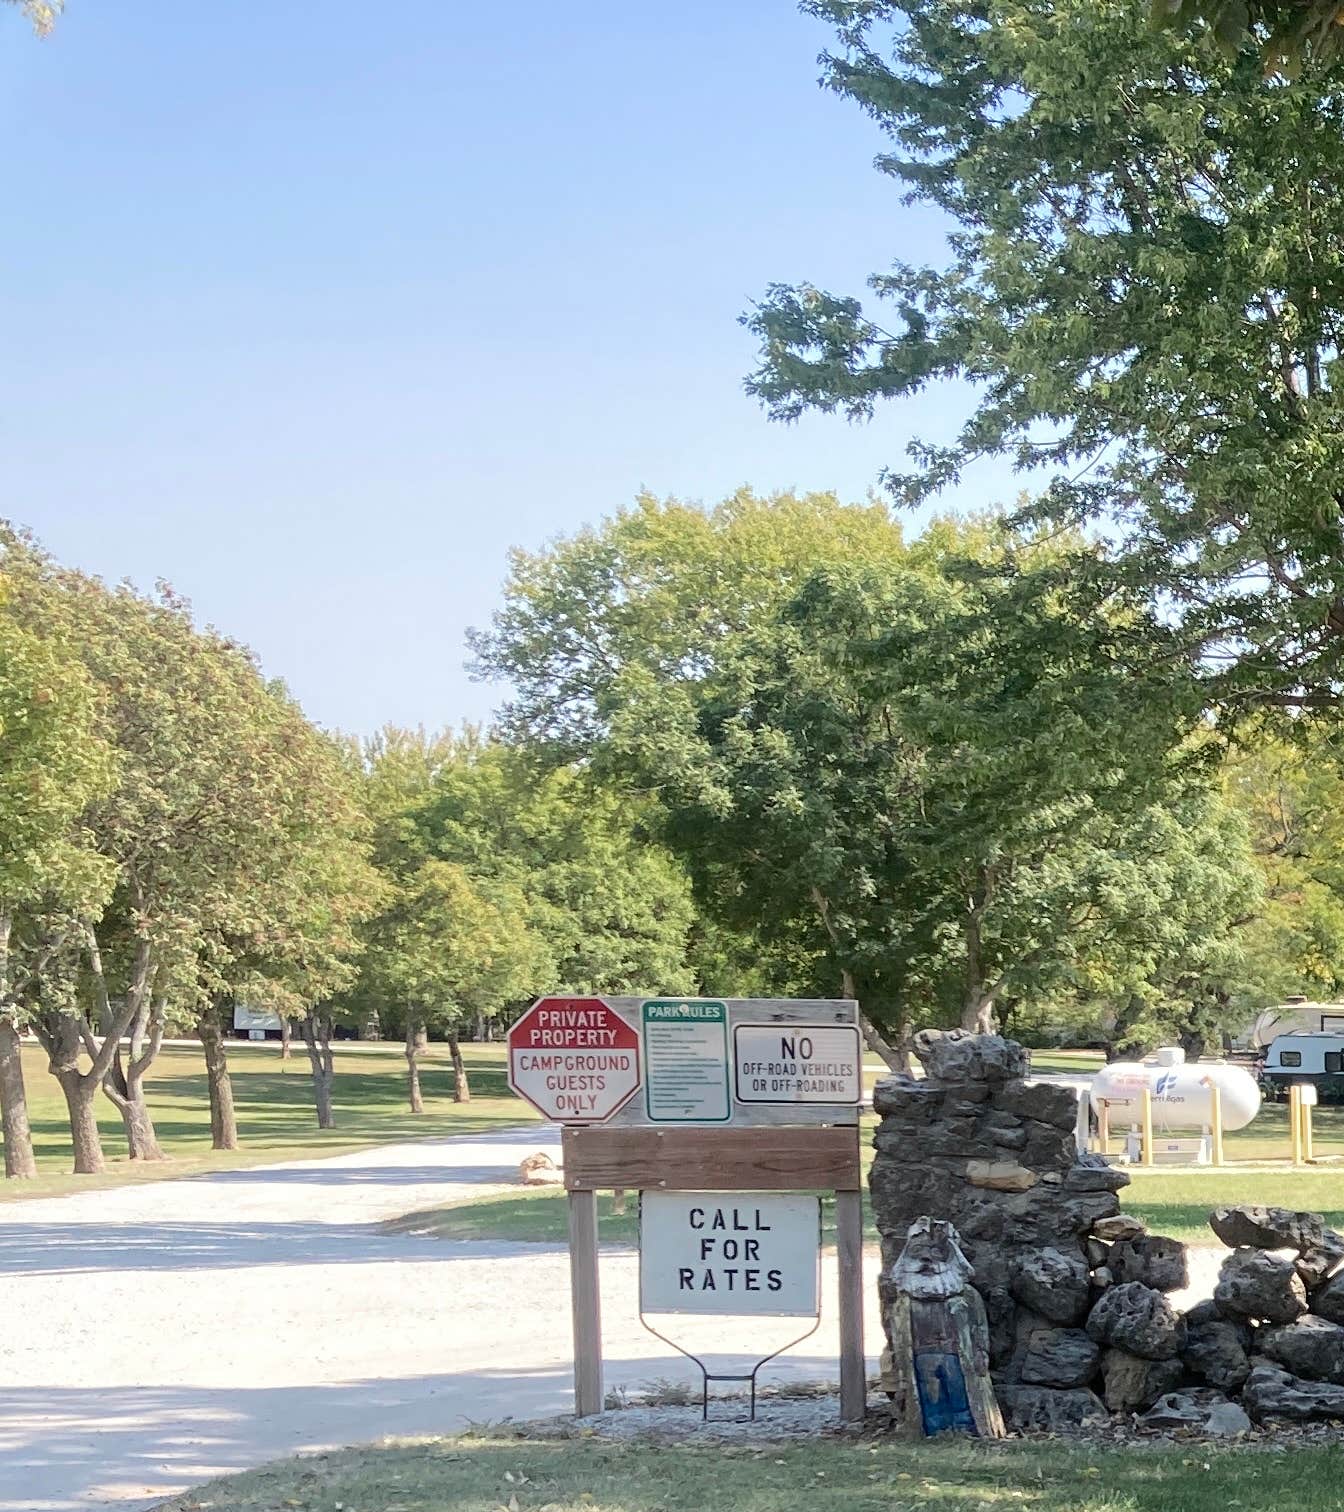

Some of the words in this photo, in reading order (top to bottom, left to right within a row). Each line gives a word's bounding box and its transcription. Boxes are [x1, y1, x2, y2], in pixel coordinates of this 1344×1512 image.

[538, 1011, 608, 1027] PRIVATE
[648, 1007, 680, 1017] PARK
[530, 1029, 617, 1046] PROPERTY
[781, 1037, 813, 1060] NO
[520, 1055, 630, 1071] CAMPGROUND
[743, 1062, 797, 1076] OFF-ROAD
[800, 1063, 853, 1077] VEHICLES
[546, 1075, 606, 1091] GUESTS
[752, 1079, 767, 1092] OR
[771, 1079, 845, 1093] OFF-ROADING
[556, 1095, 597, 1111] ONLY
[689, 1208, 771, 1231] CALL
[701, 1238, 760, 1261] FOR
[679, 1268, 783, 1292] RATES
